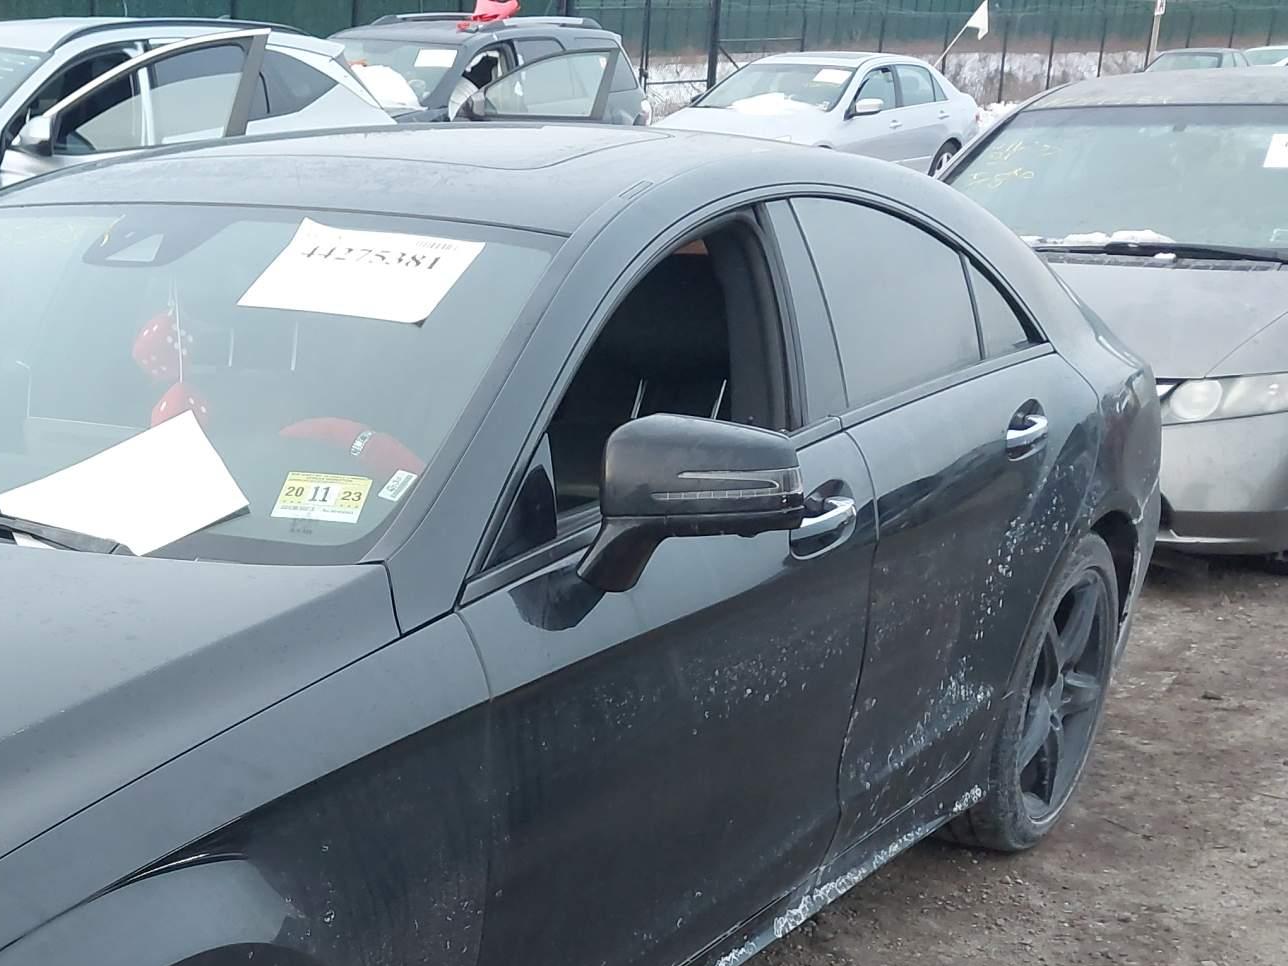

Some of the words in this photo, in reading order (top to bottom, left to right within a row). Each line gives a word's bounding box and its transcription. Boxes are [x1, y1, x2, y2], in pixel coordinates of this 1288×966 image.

[300, 245, 441, 270] 44275381
[285, 486, 305, 497] 20
[309, 485, 331, 502] 11
[341, 491, 362, 502] 23
